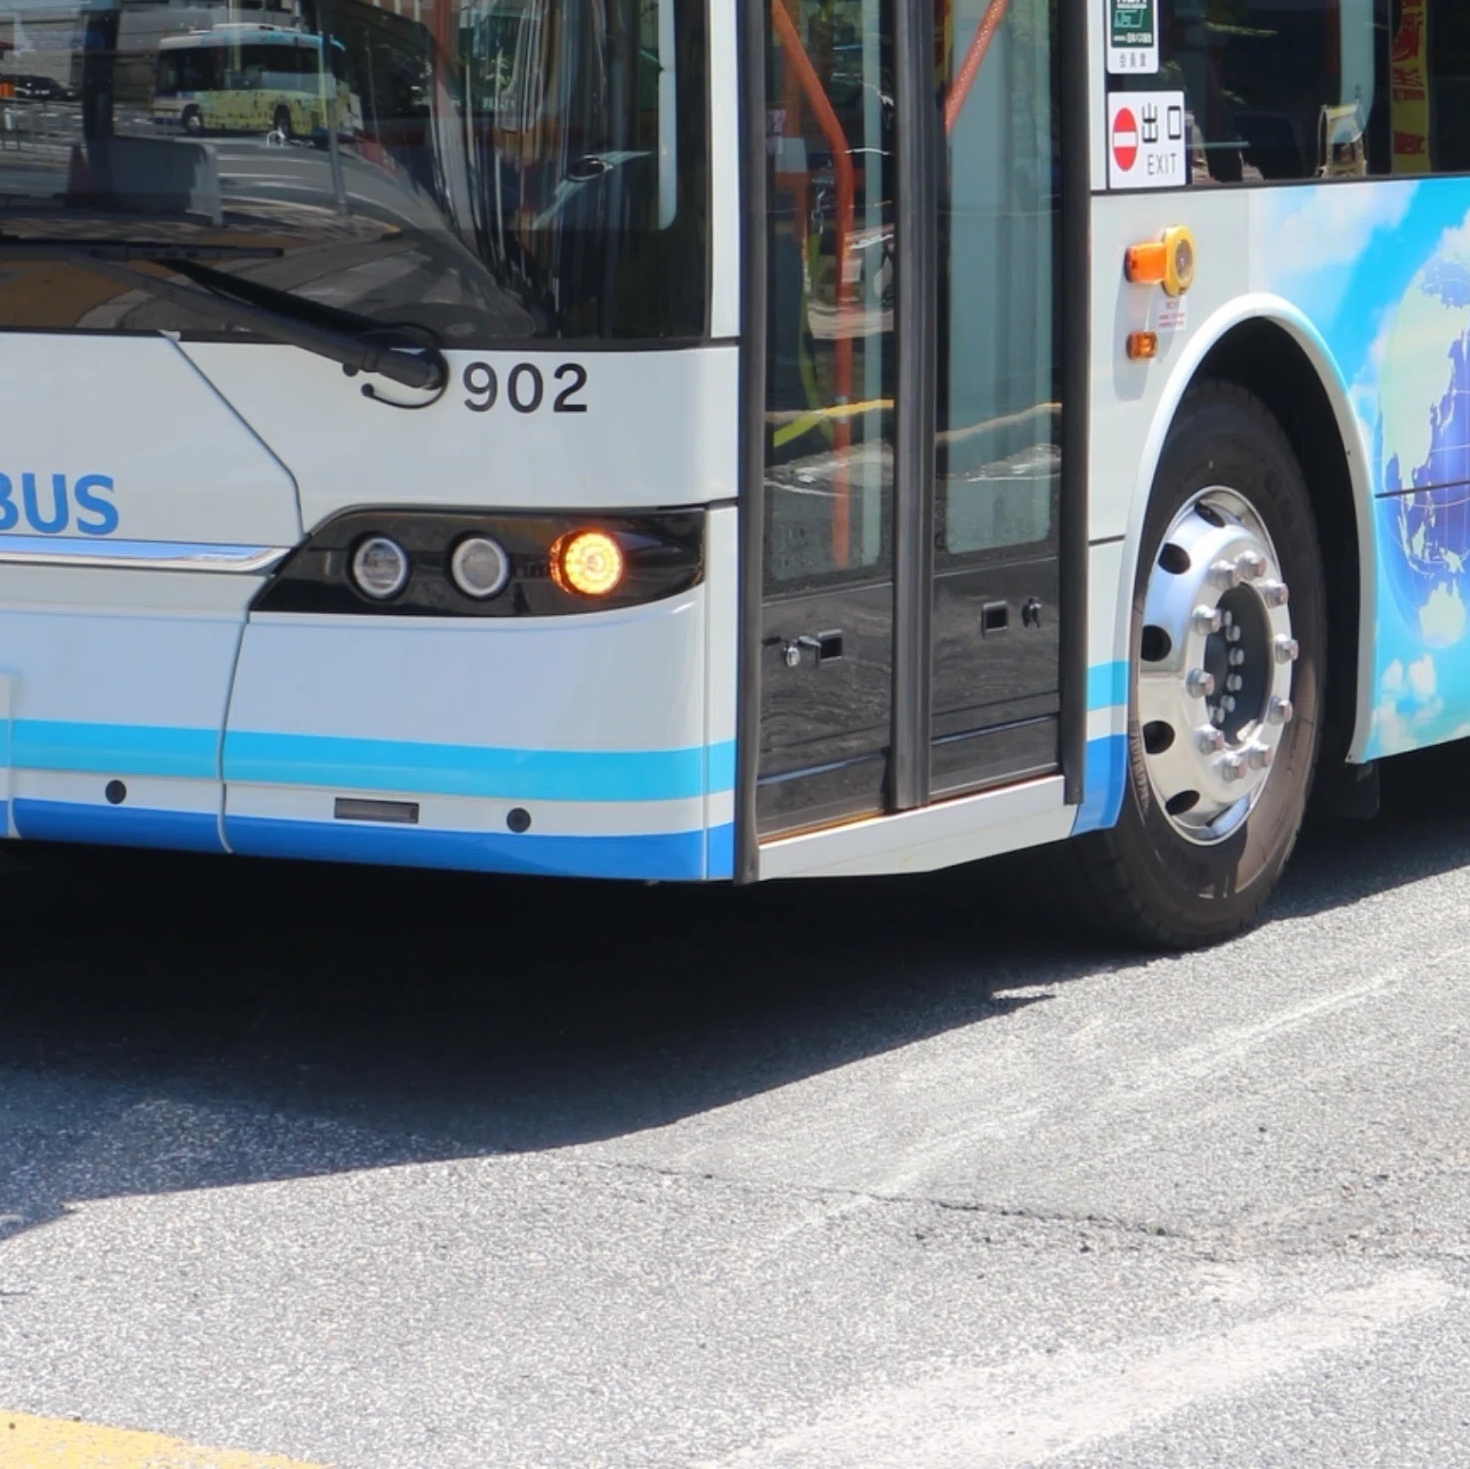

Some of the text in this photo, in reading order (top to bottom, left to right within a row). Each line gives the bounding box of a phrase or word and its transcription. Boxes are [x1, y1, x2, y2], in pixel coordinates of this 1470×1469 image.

[1142, 103, 1181, 143] 出口
[1147, 153, 1177, 176] EXIT
[462, 361, 589, 414] 902
